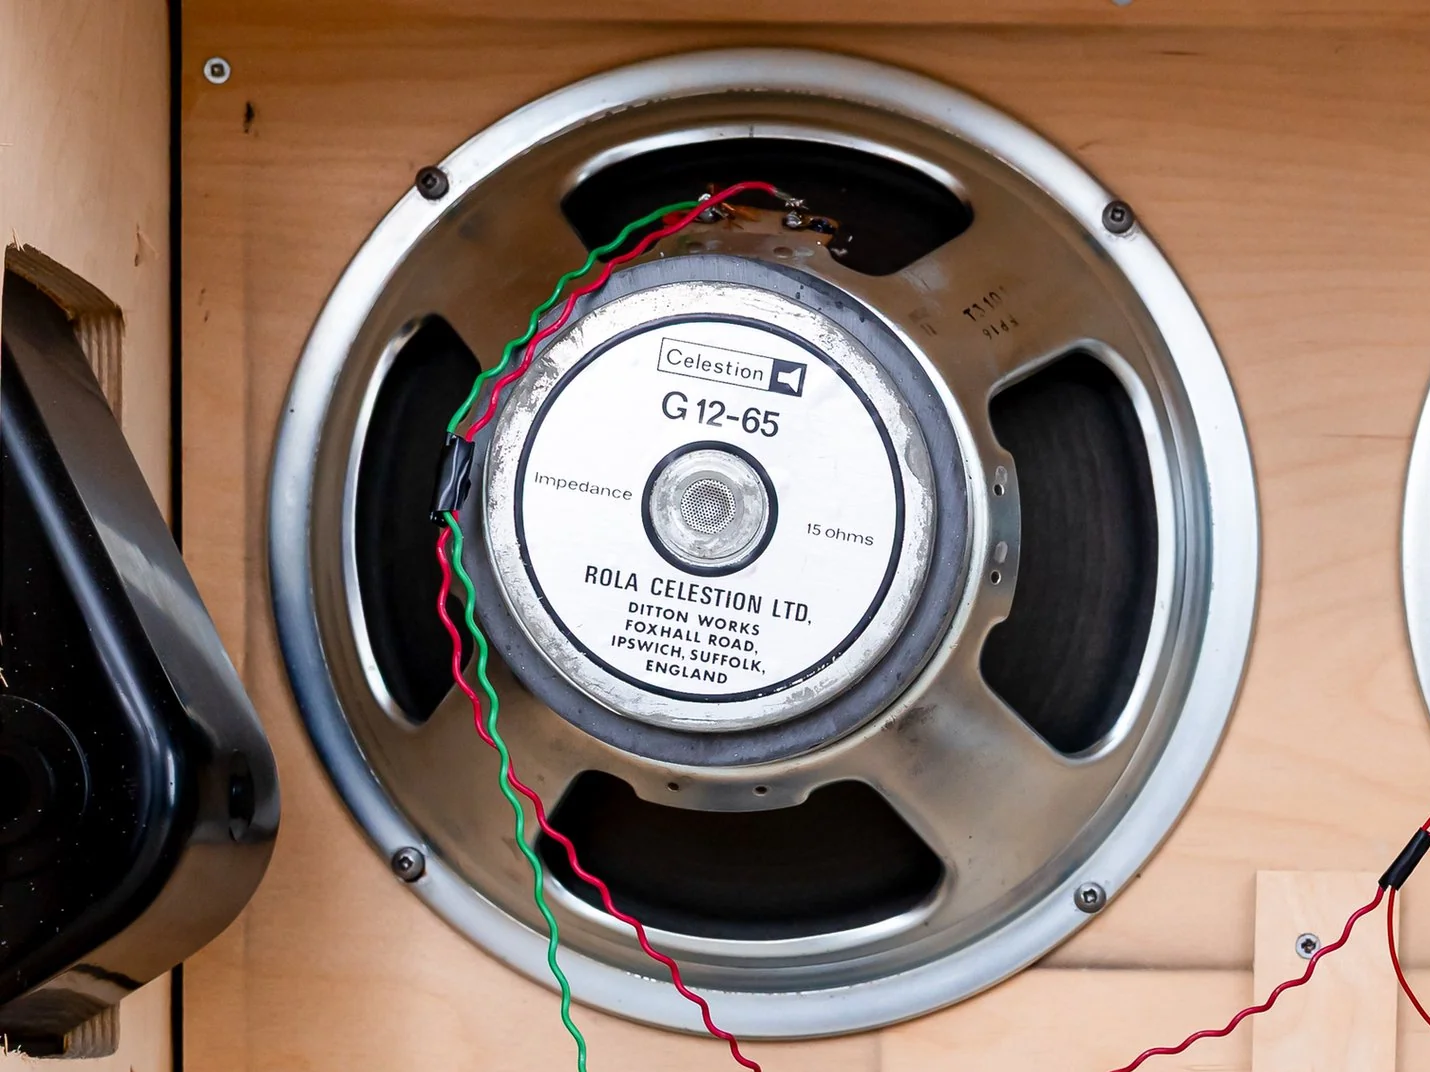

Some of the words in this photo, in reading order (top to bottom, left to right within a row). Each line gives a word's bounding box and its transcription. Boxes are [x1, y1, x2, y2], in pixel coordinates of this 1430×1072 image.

[665, 348, 765, 383] Celestion
[534, 471, 633, 501] Impedance
[806, 523, 821, 536] 15
[825, 525, 874, 547] ohms
[584, 565, 638, 592] ROLA
[650, 577, 762, 614] CELESTION
[628, 602, 689, 623] DITTON
[698, 614, 760, 636] WORKS
[625, 619, 701, 643] FOXHALL
[708, 634, 758, 655] ROAD,
[611, 635, 685, 660] IPSWICH,
[690, 649, 766, 675] SUFFOLK,
[645, 660, 728, 684] ENGLAND
